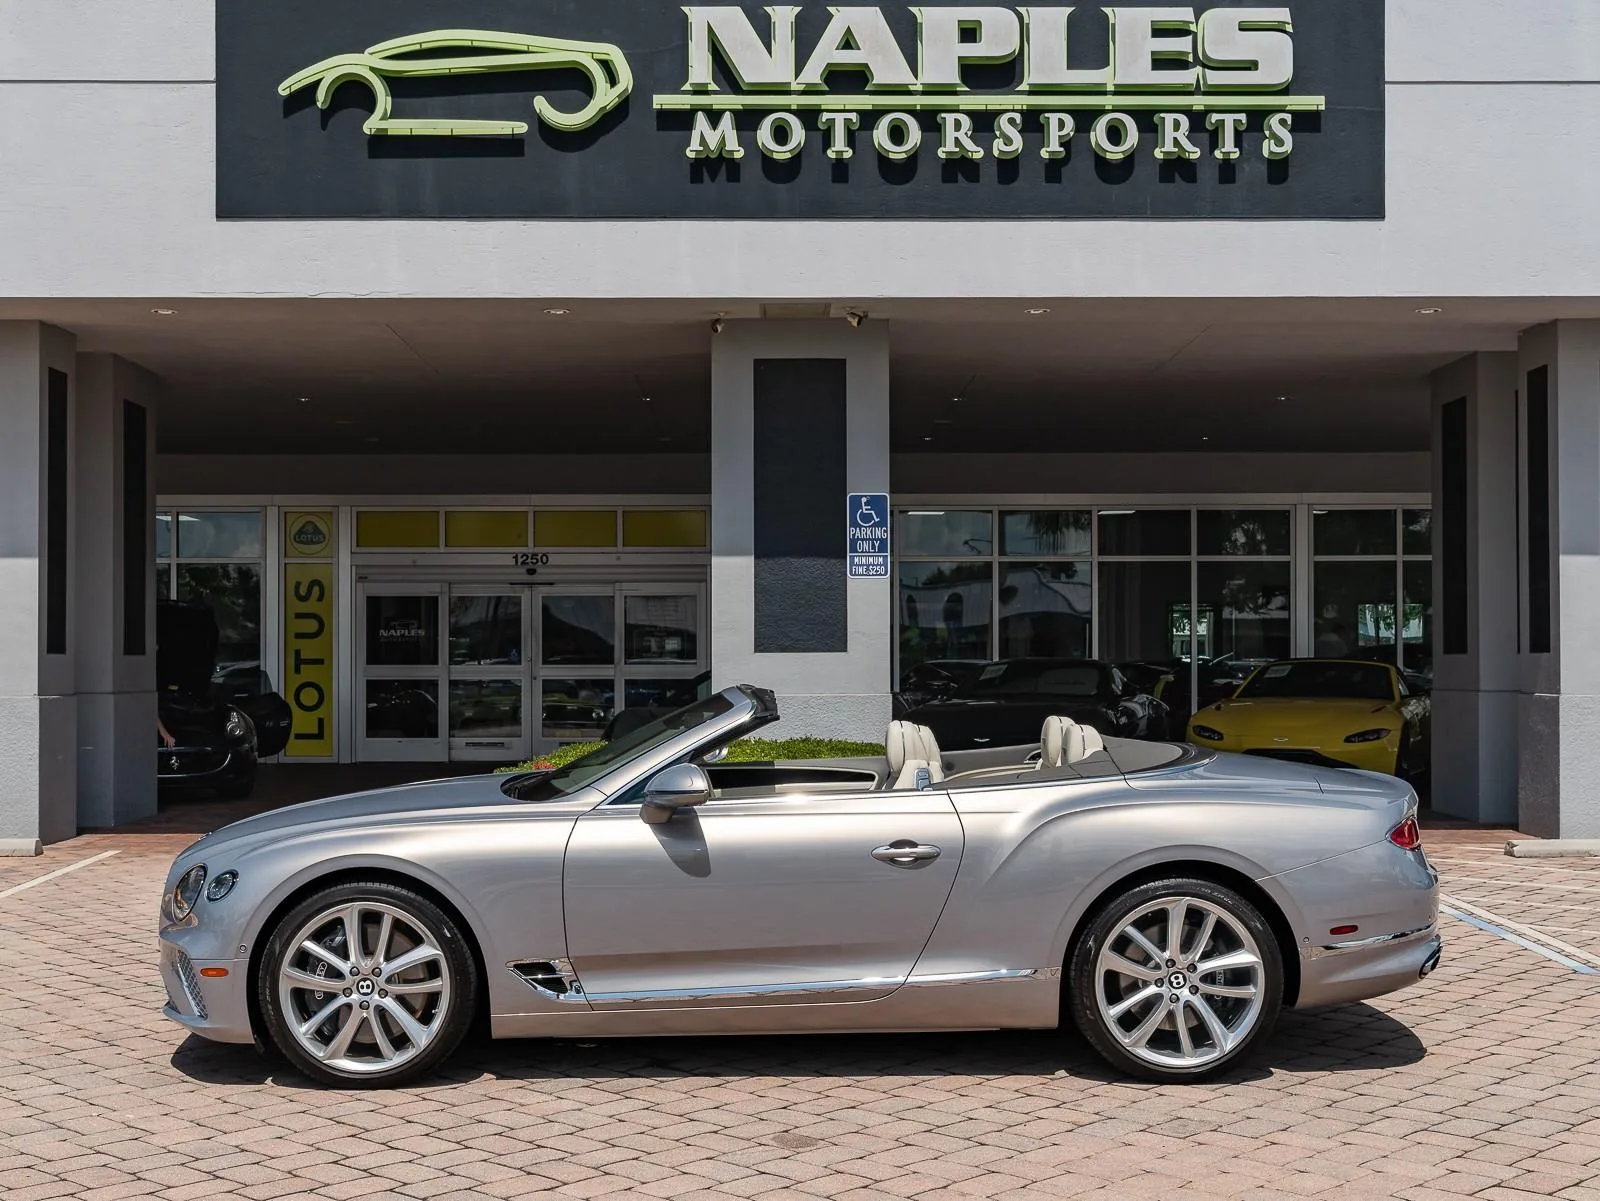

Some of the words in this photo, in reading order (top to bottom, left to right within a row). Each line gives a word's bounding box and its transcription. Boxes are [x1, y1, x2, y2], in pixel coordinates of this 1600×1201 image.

[680, 6, 1294, 91] NAPLES
[686, 111, 1293, 159] MOTORSPORTS
[295, 534, 325, 542] LOTUS
[850, 528, 887, 538] PARKING
[857, 541, 880, 552] ONLY
[512, 553, 549, 566] 1250
[854, 556, 882, 564] MINIMUM
[378, 629, 425, 637] NAPLES
[294, 579, 325, 740] LOTUS
